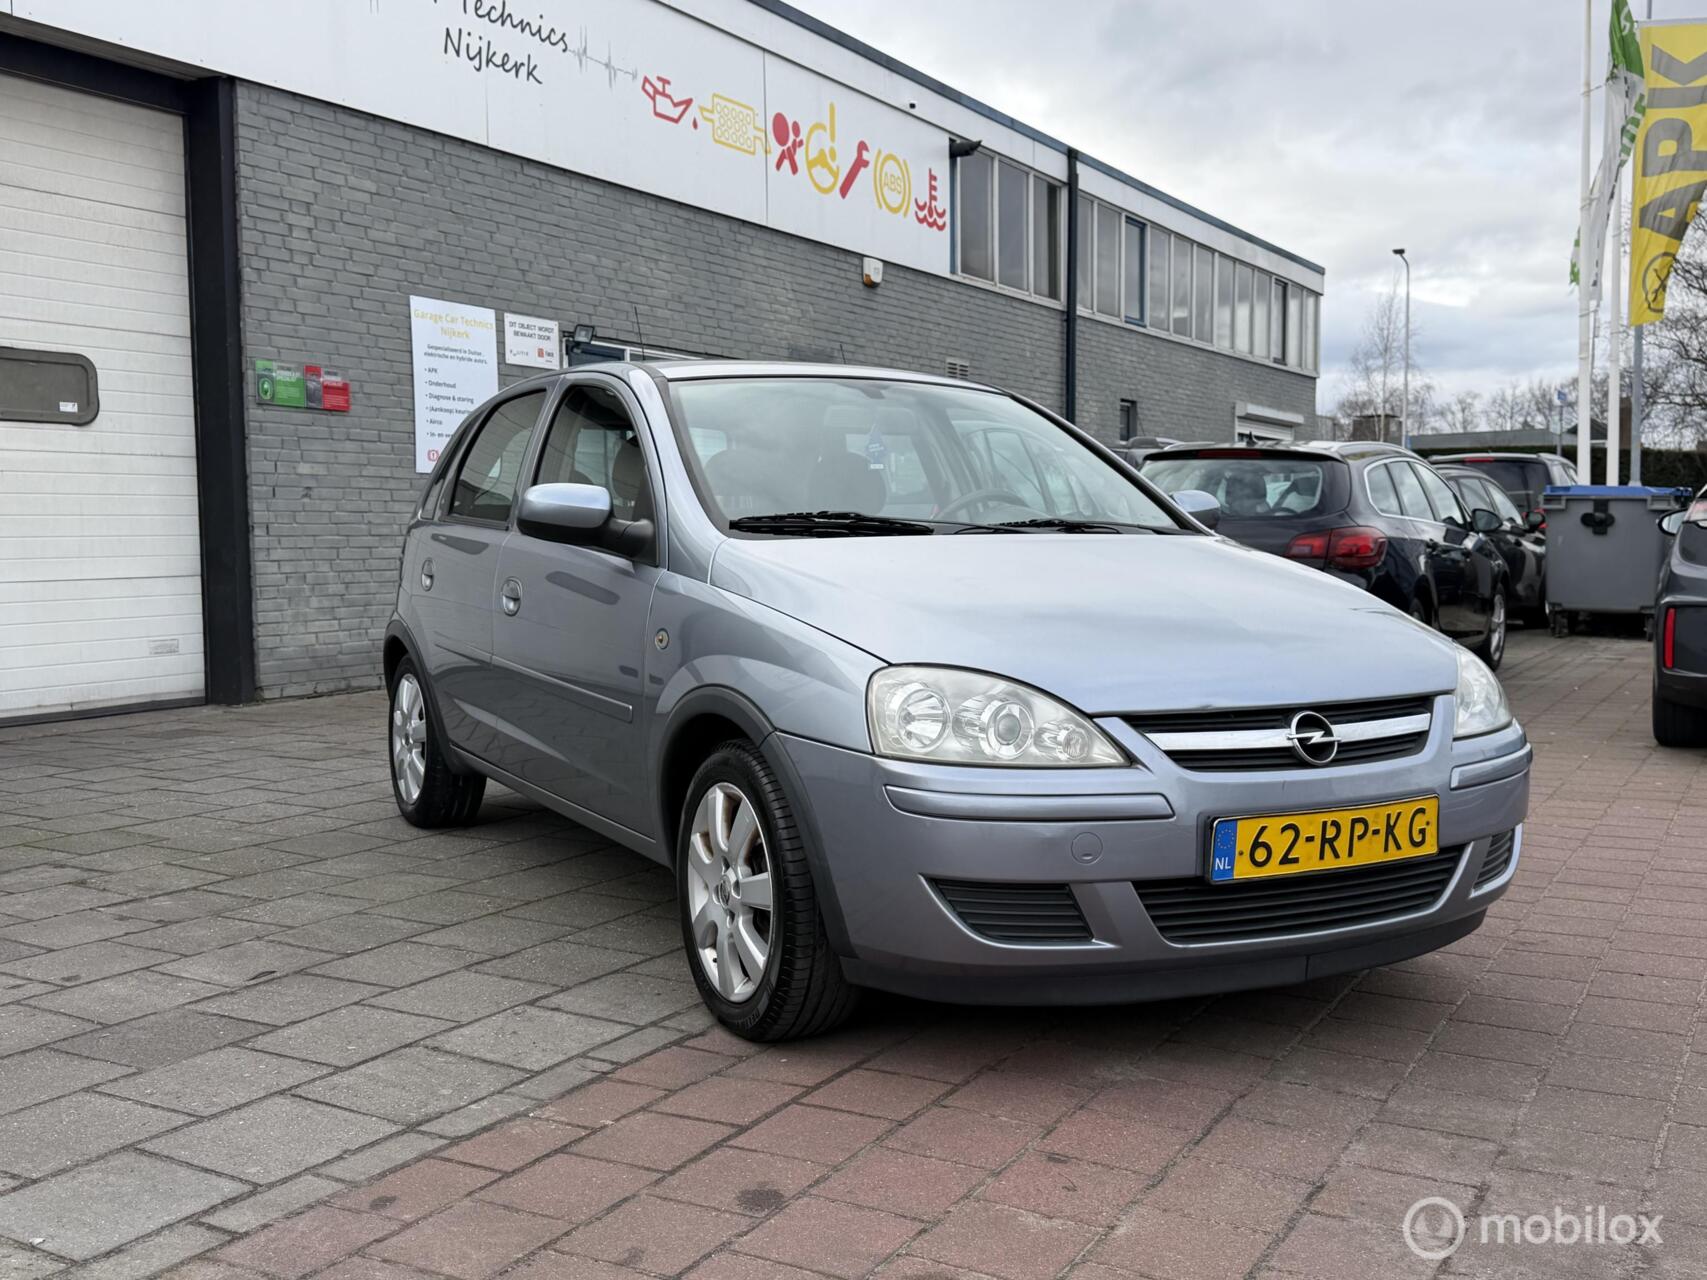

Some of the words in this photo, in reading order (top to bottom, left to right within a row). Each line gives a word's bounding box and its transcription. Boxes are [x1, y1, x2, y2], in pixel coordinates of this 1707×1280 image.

[444, 27, 543, 84] Nijkerk
[1639, 44, 1707, 242] APK
[883, 172, 902, 195] ABS
[413, 309, 443, 324] Garage
[445, 313, 459, 324] Car
[460, 316, 494, 329] Technics
[440, 327, 470, 339] Nijkerk
[513, 329, 537, 339] BEWAAKT
[537, 333, 551, 341] DOOR
[518, 322, 537, 331] OBJECT
[537, 326, 554, 334] WORDT
[428, 379, 457, 389] Onderhoud
[428, 392, 451, 402] Diagnose
[1215, 857, 1231, 871] NL
[1249, 807, 1427, 868] 62-RP-KG
